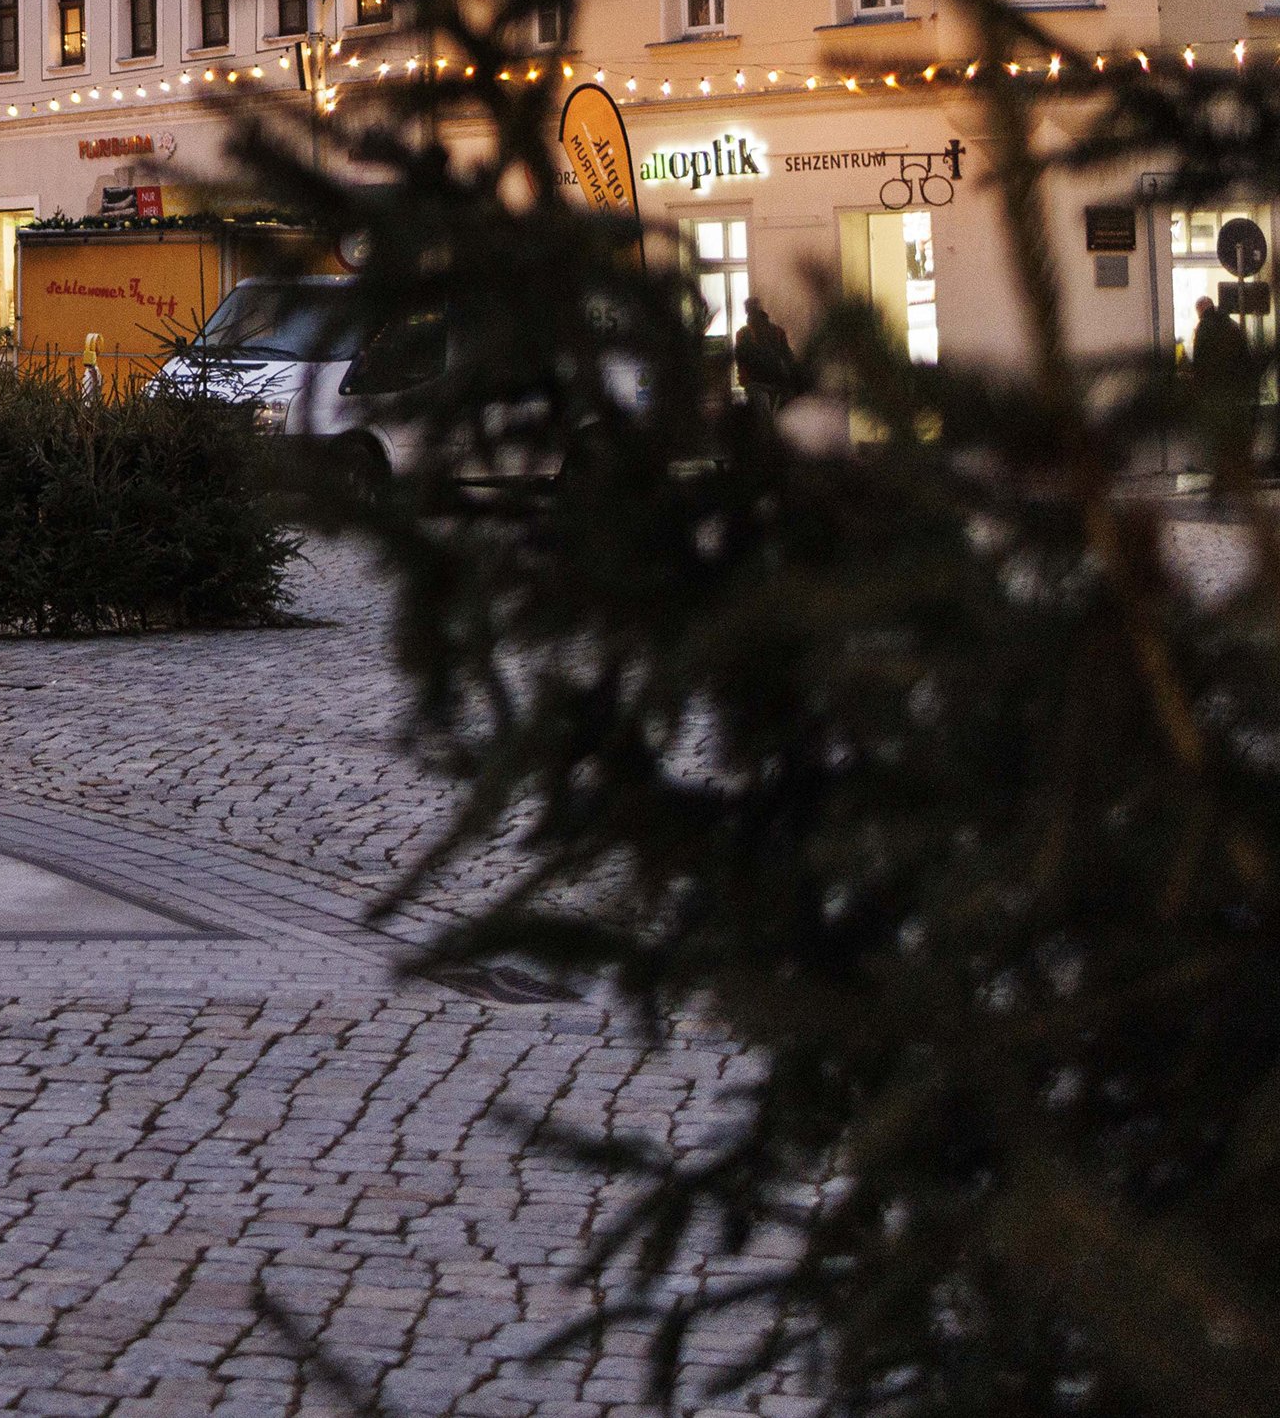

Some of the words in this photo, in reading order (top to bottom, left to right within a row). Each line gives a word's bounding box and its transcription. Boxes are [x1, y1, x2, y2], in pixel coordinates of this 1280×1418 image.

[640, 134, 760, 190] alloptik
[785, 152, 887, 172] SEHZENTRUM
[141, 192, 156, 202] NUR
